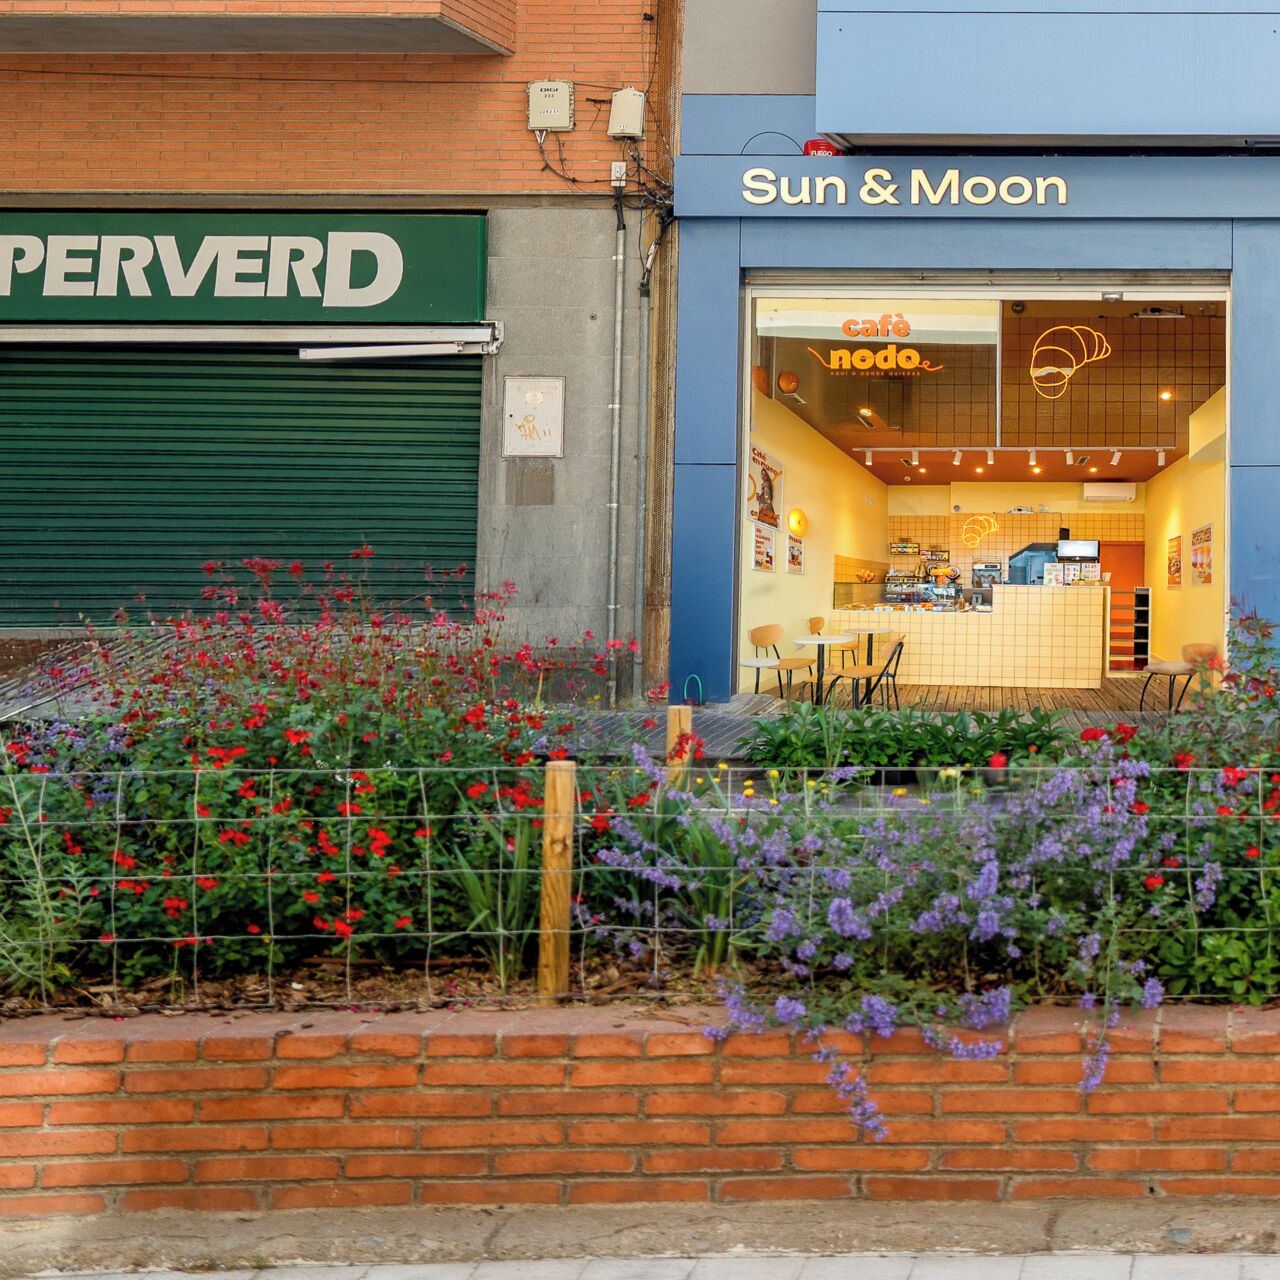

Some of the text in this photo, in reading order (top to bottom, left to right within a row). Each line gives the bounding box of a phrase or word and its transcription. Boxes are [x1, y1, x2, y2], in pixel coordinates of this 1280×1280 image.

[741, 167, 1068, 205] Sun & Moon
[829, 344, 921, 370] nodo
